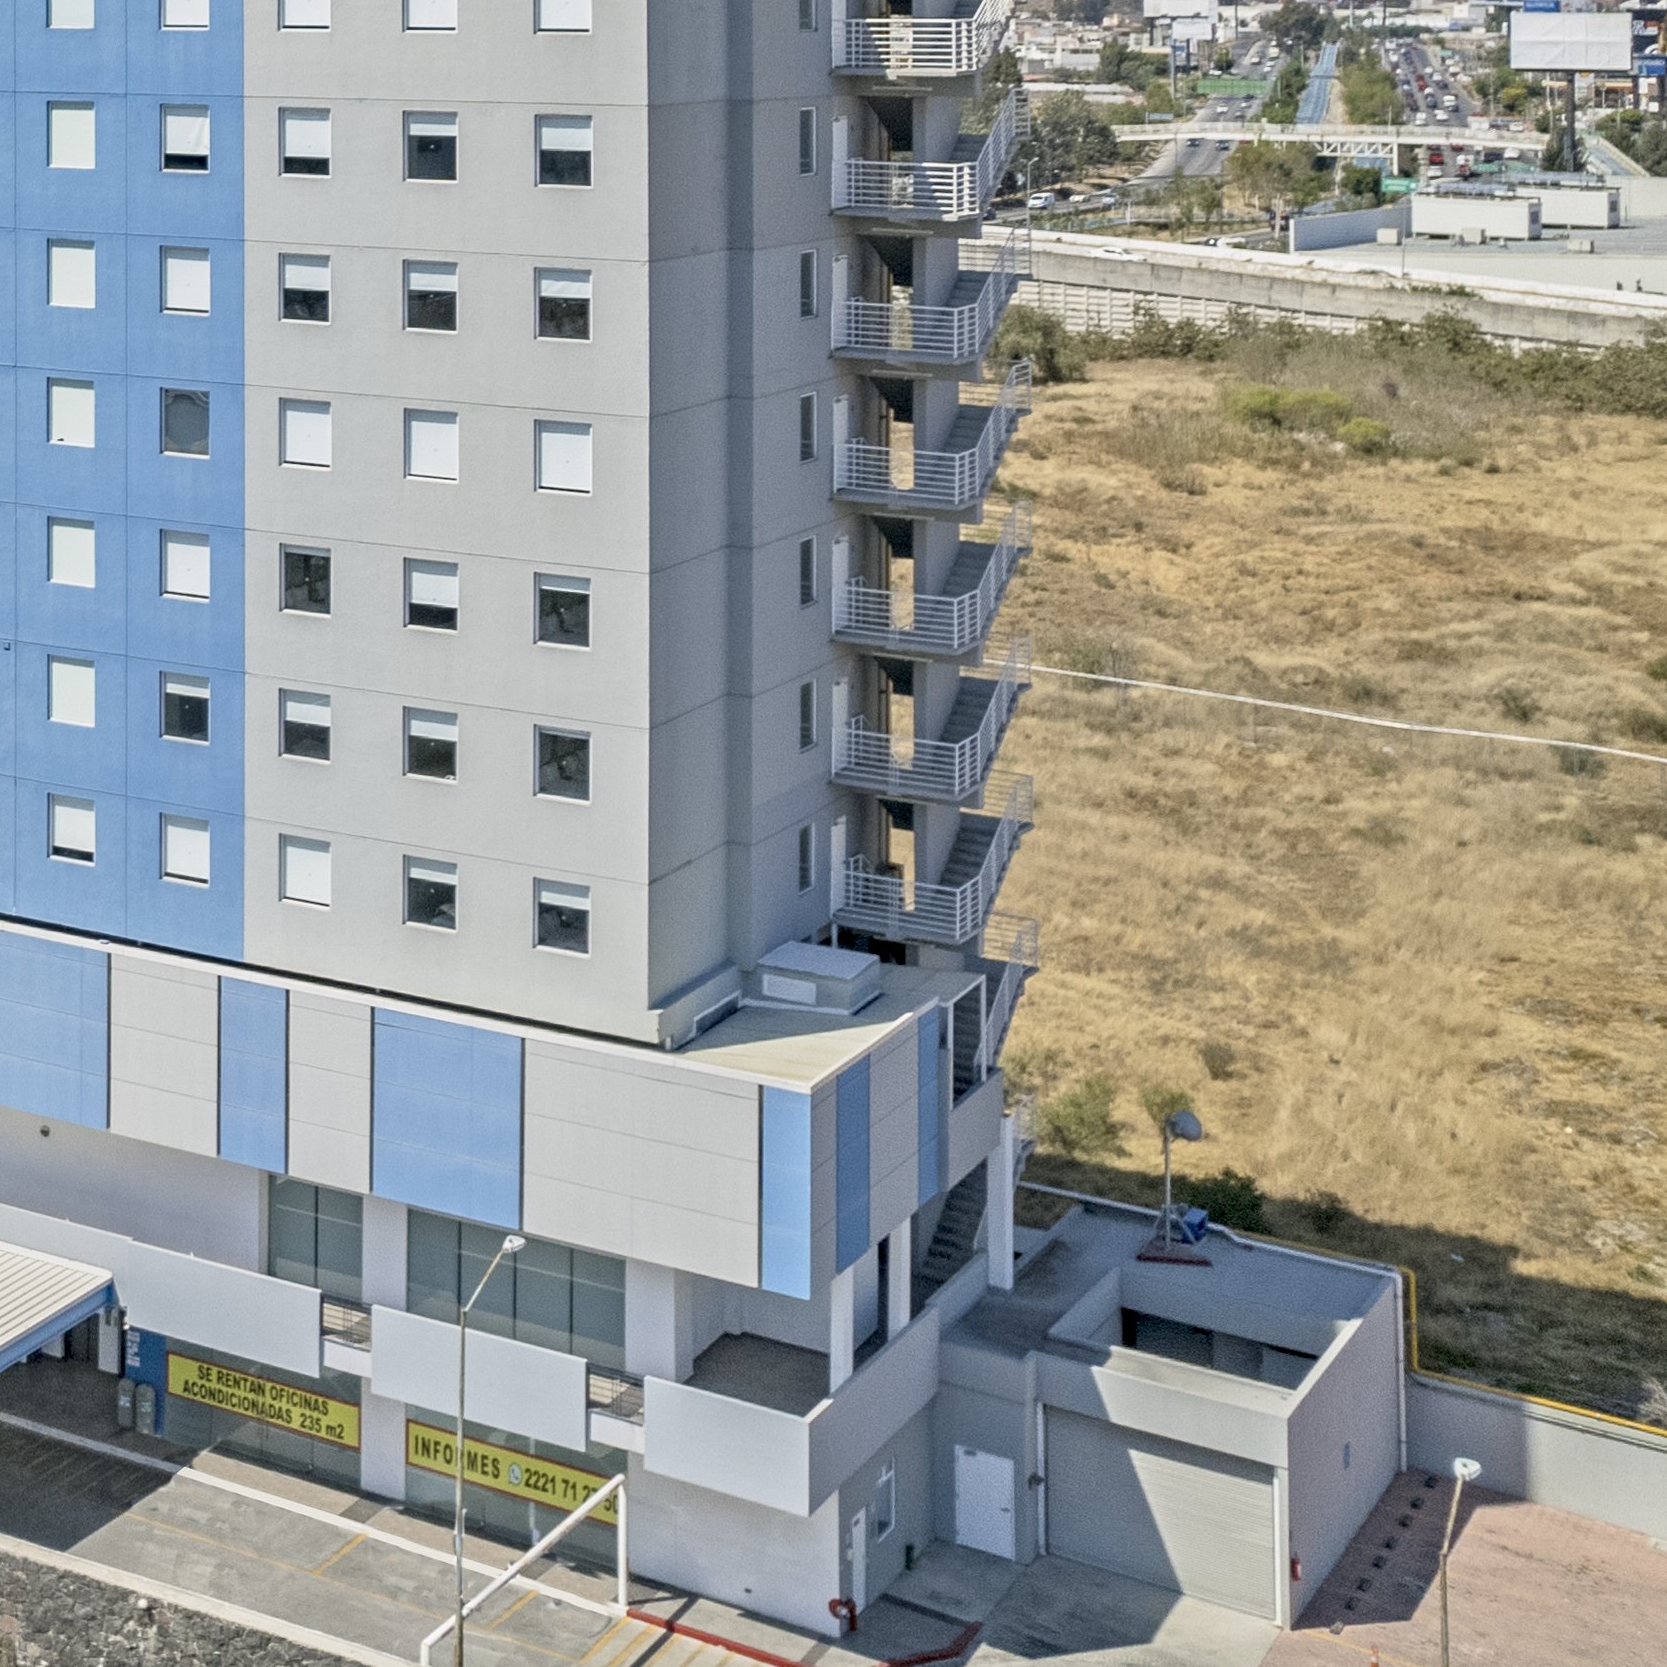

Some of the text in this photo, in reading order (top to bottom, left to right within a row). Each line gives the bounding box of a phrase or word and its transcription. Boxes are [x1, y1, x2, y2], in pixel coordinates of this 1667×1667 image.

[183, 1379, 345, 1441] ACONDICIONADAS 235 m2
[198, 1364, 330, 1417] SE RENTAN OFICINAS
[414, 1435, 501, 1480] INFOMES
[524, 1467, 557, 1496] 2221
[561, 1478, 578, 1502] 71
[581, 1484, 598, 1503] 2
